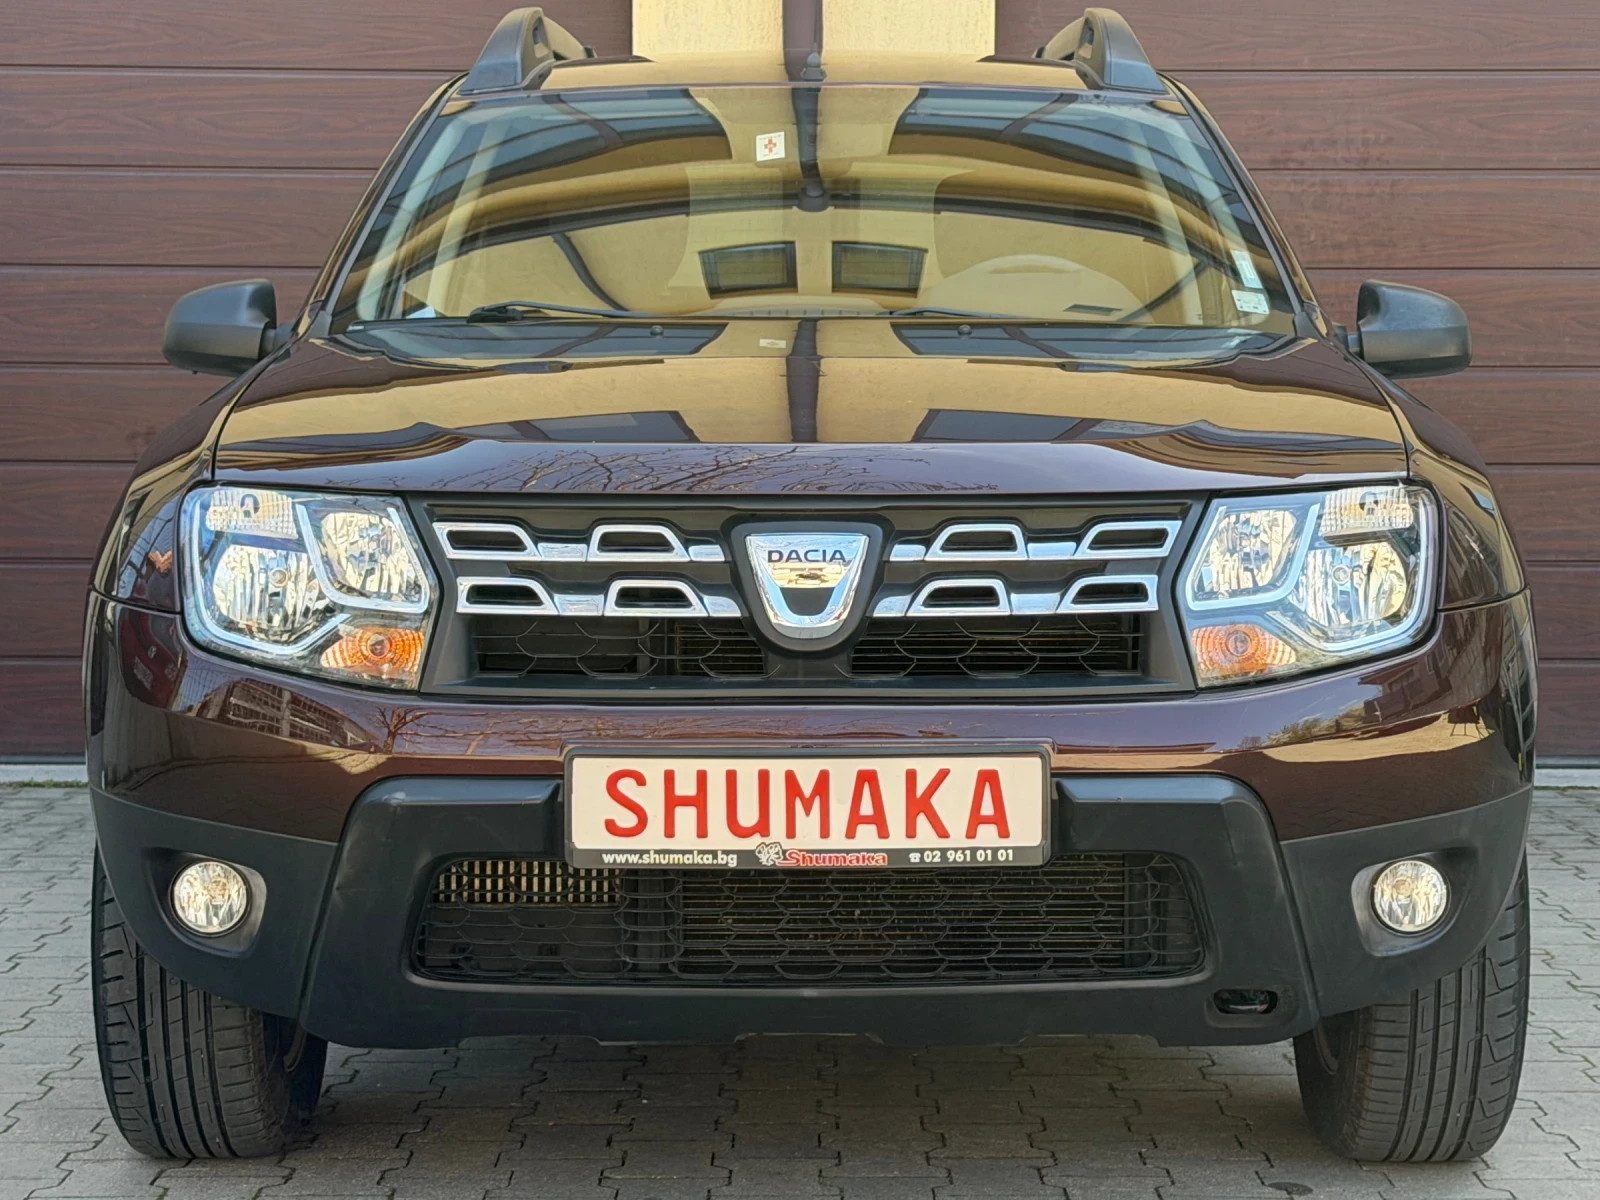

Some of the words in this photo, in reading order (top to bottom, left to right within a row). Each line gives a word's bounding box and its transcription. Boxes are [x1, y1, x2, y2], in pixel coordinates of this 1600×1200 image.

[767, 549, 847, 563] DACIA
[604, 768, 1011, 839] SHUMAKA
[601, 849, 738, 867] www.shumaka.bg
[776, 849, 888, 866] Shumaka
[923, 850, 941, 862] 02
[946, 850, 971, 862] 961
[976, 849, 992, 861] 01
[997, 849, 1013, 861] 01
